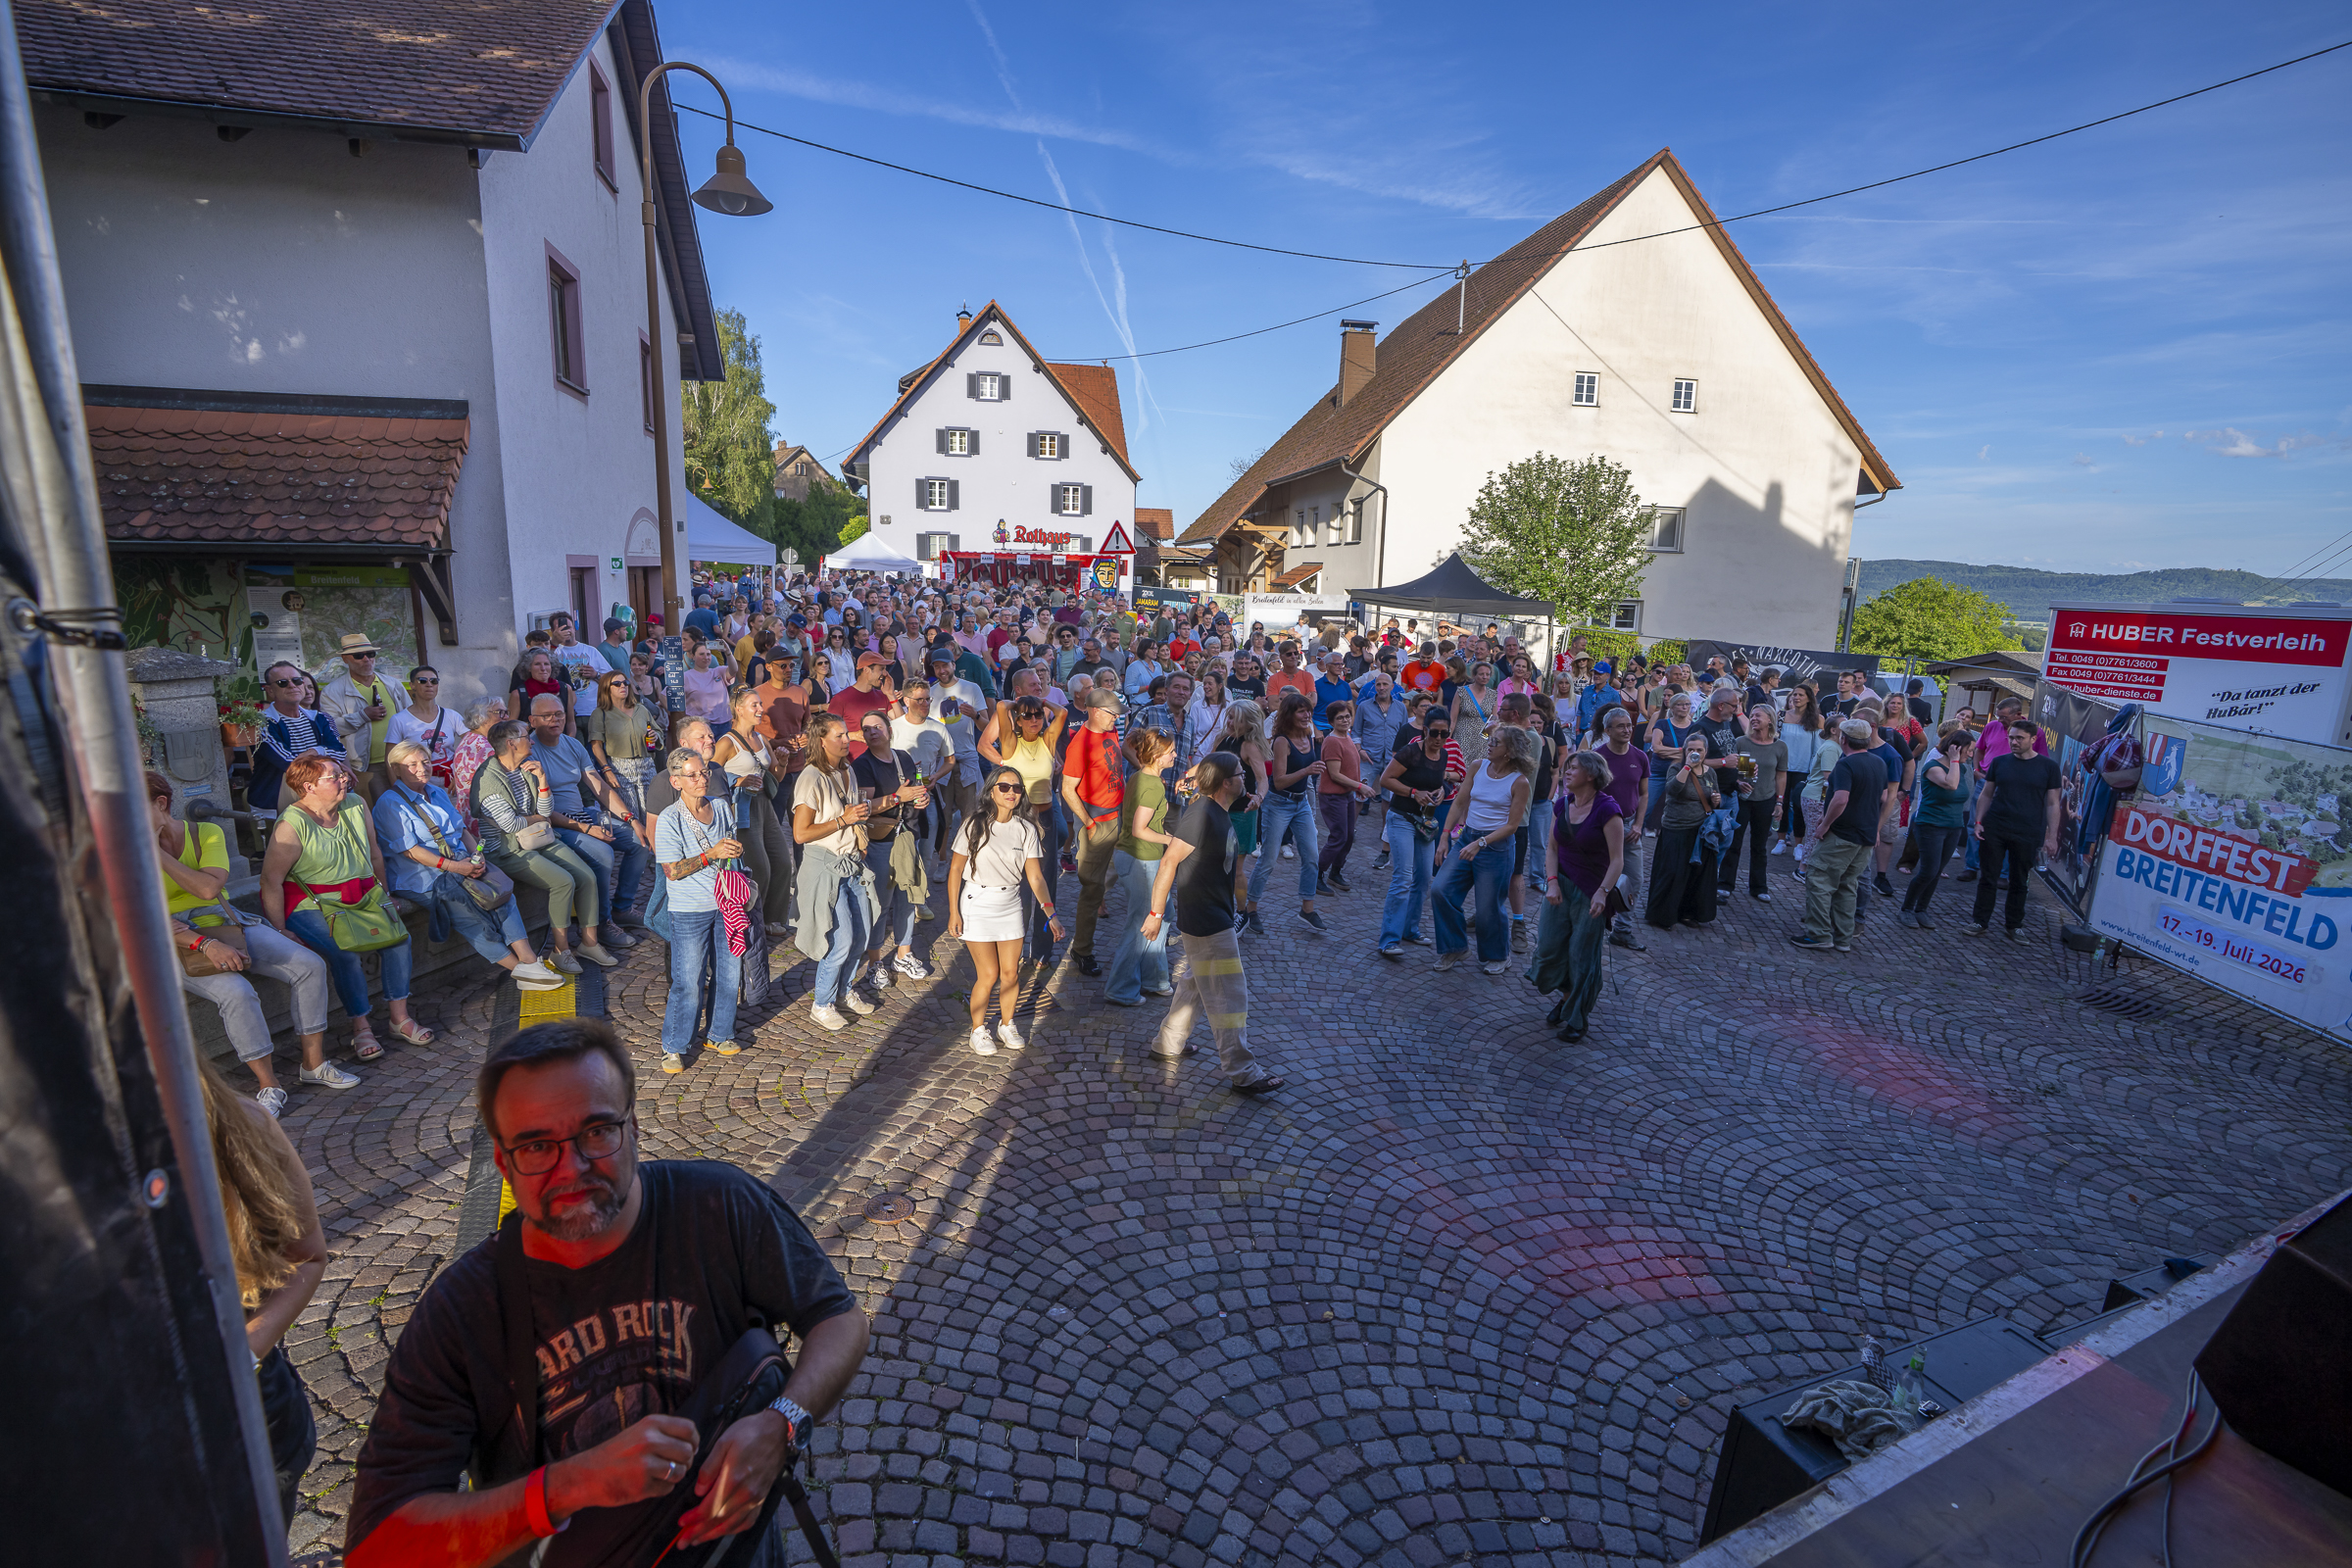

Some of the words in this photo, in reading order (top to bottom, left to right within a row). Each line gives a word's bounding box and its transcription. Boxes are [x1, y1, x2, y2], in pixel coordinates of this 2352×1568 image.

[1013, 524, 1071, 547] Rothaus
[311, 575, 360, 584] Breitenfeld
[1136, 598, 1159, 607] JAMARAM
[1251, 594, 1286, 605] Breitenfeld
[1307, 596, 1324, 606] Zeiten
[2091, 623, 2174, 644] HUBER
[2180, 627, 2327, 652] Festverleih
[1755, 646, 1823, 679] NARCOTIK
[2054, 653, 2069, 662] Tel.
[2072, 655, 2094, 664] 0049
[2095, 656, 2158, 669] (0)7761/3600
[2051, 667, 2068, 676] Fax
[2070, 668, 2092, 678] 0049
[2094, 670, 2156, 684] (0)7761/3444
[2244, 685, 2287, 701] tanzt
[2289, 682, 2321, 695] der
[2124, 810, 2299, 891] DORFFEST
[2115, 848, 2338, 951] BREITENFELD
[2100, 917, 2201, 966] www.breitenfeld-wt.de
[2223, 939, 2255, 964] Juli
[2258, 953, 2305, 984] 2026
[535, 1313, 608, 1380] ARD
[612, 1298, 696, 1382] ROCK
